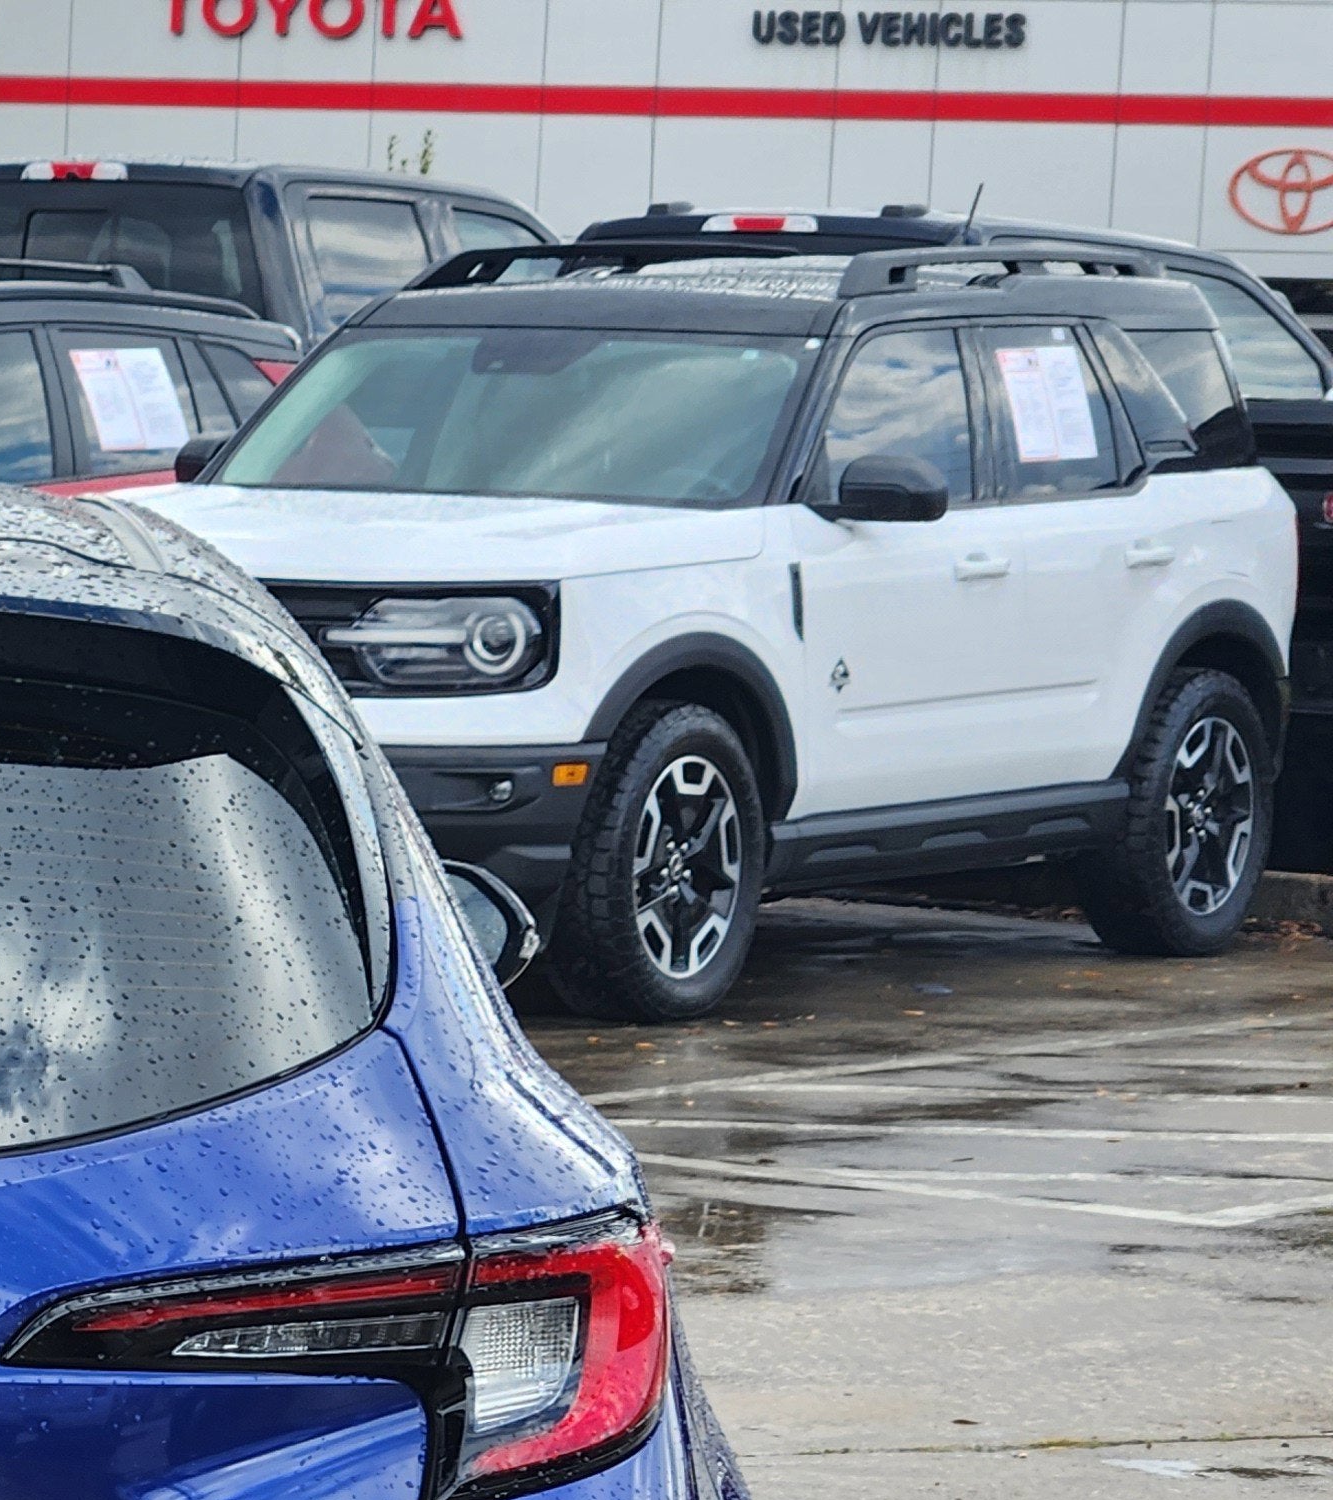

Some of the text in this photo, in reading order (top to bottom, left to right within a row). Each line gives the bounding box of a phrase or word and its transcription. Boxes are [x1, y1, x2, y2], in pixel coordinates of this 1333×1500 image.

[170, 0, 463, 39] TOYOTA
[752, 10, 1027, 49] USED VEHICLES
